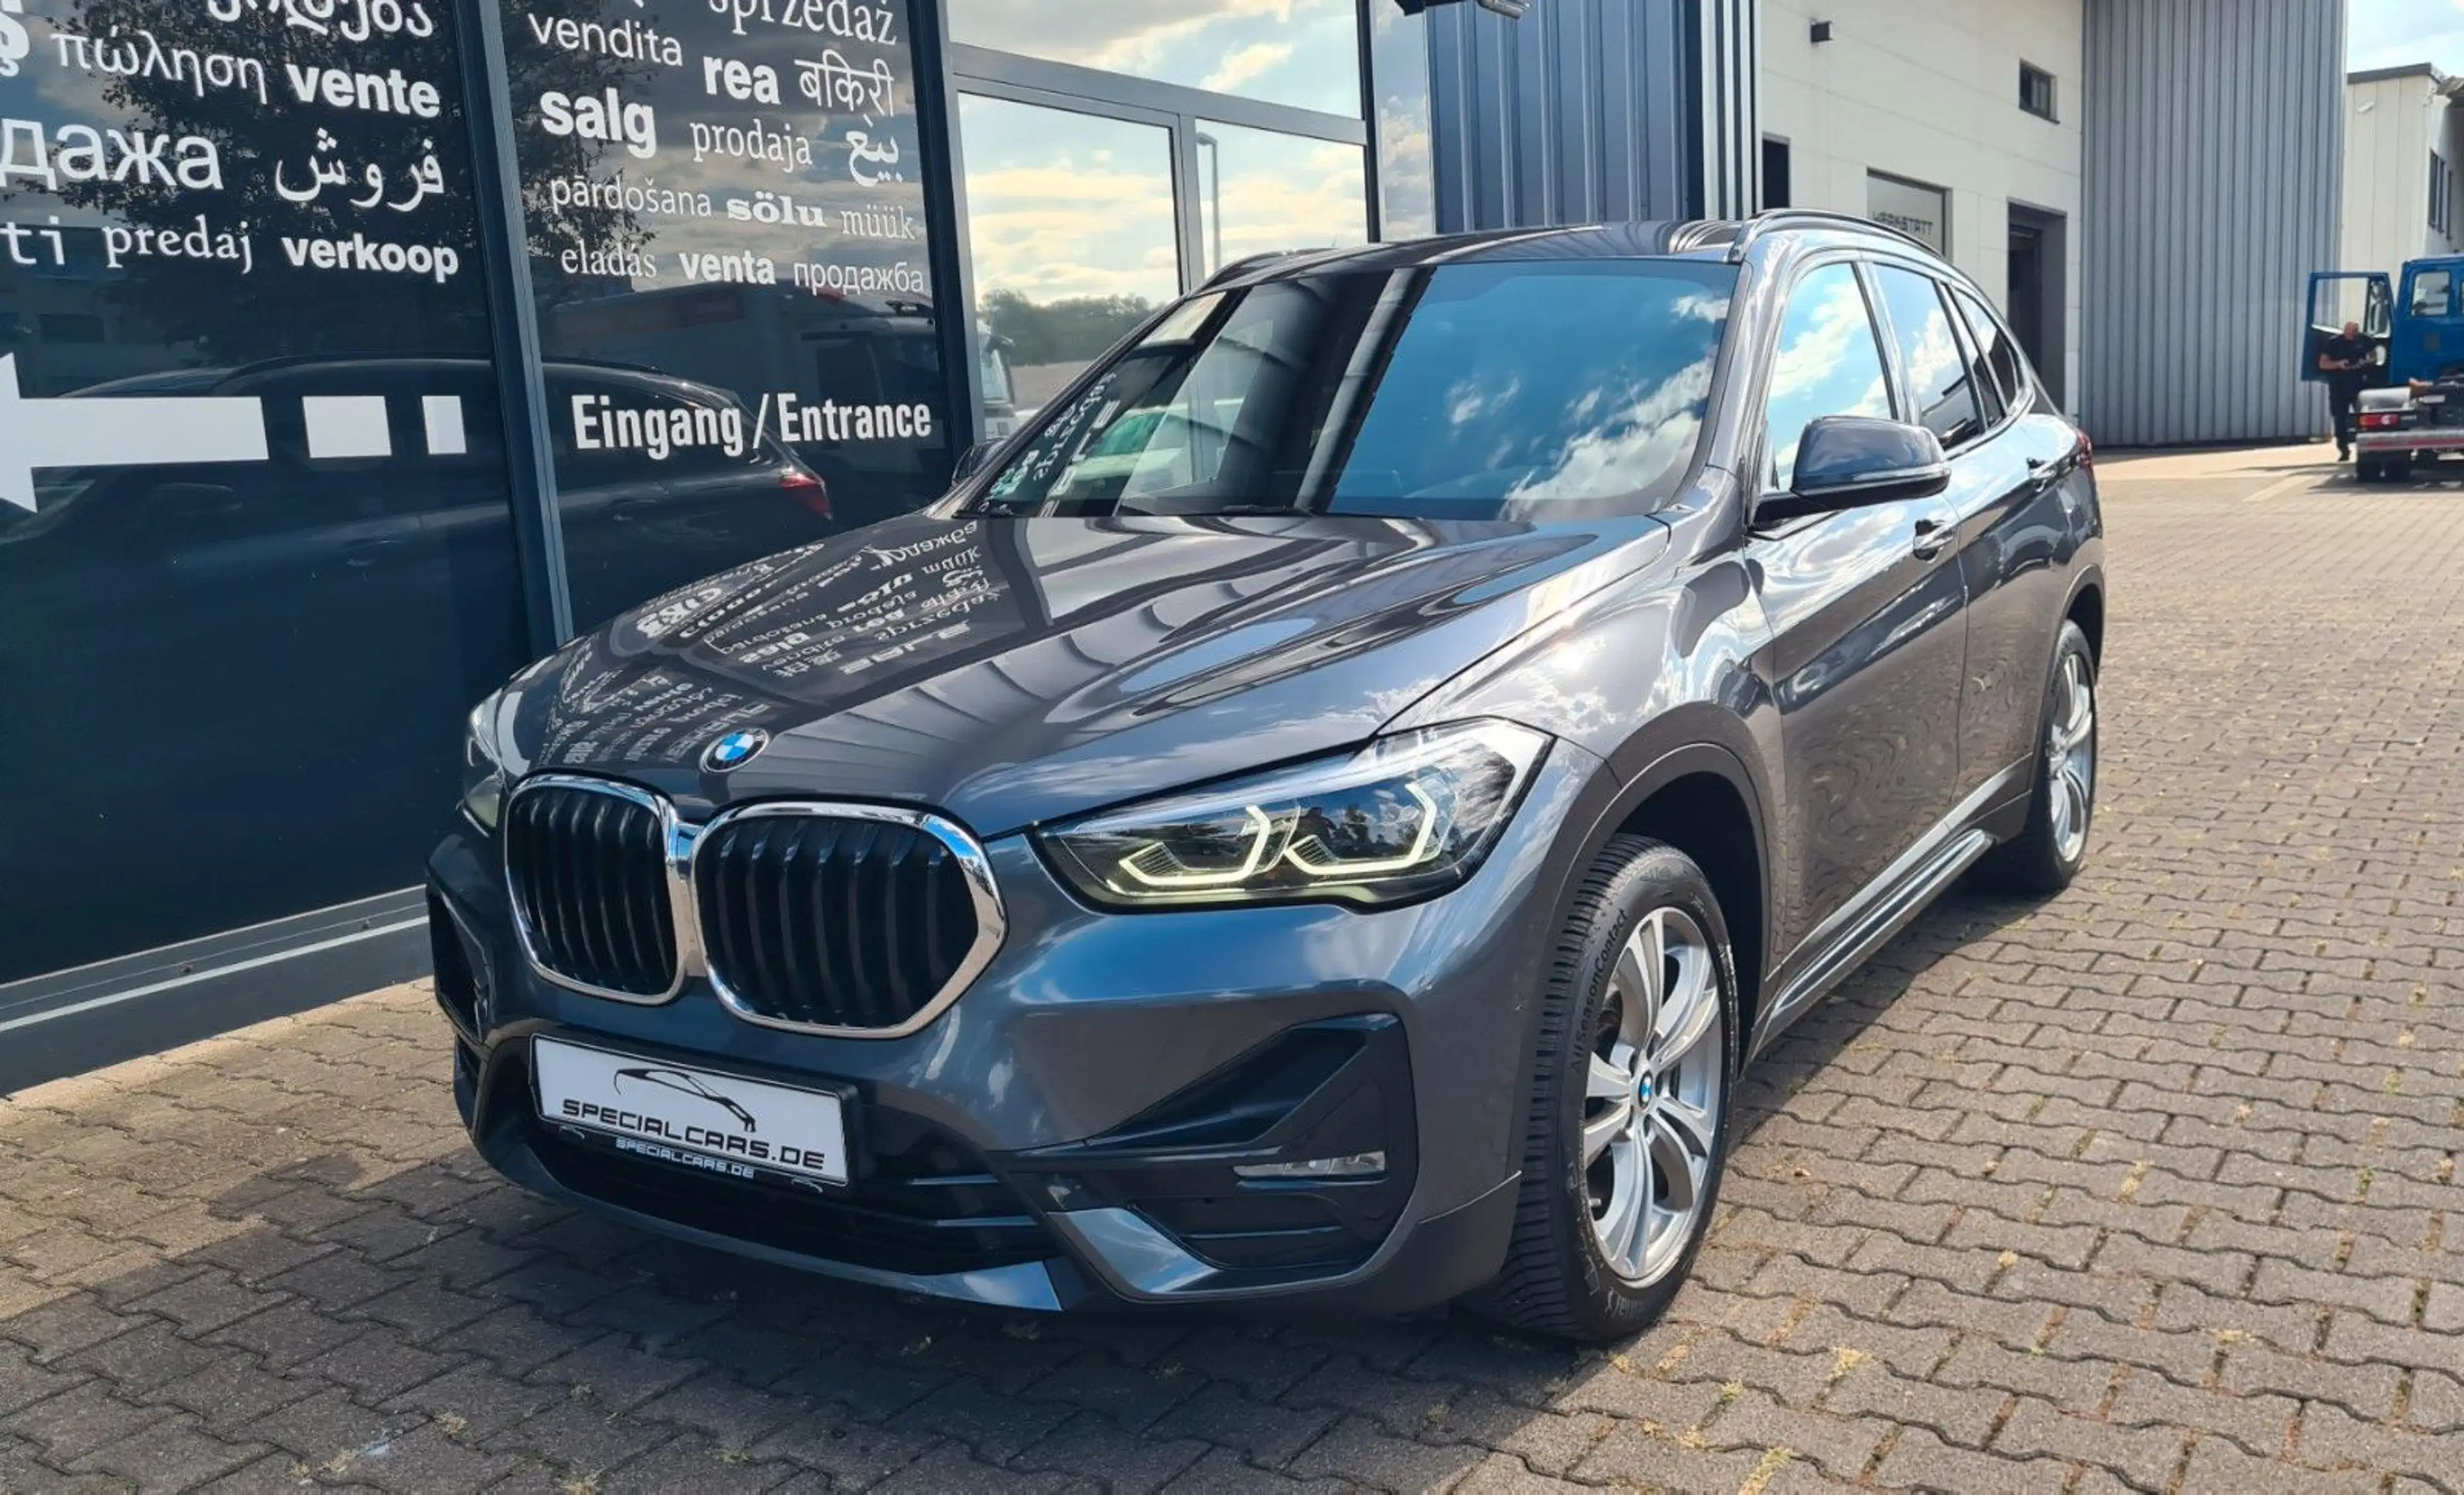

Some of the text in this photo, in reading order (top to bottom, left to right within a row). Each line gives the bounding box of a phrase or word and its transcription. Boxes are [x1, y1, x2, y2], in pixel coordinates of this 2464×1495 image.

[50, 25, 268, 104] πώληση
[527, 13, 683, 67] vendita
[286, 65, 441, 118] vente
[703, 55, 782, 105] rea
[0, 118, 224, 190] дажа
[540, 87, 657, 159] salg
[690, 118, 813, 174] prodaja
[275, 128, 445, 212] فروش
[549, 175, 916, 241] pārdošana sölu müük
[101, 214, 253, 275] predaj
[280, 233, 459, 284] verkoop
[560, 240, 925, 297] eladás venta продажба
[570, 394, 744, 460] Eingang
[777, 392, 932, 444] Entrance
[563, 1098, 825, 1169] SPECIALCARS.DE
[615, 1137, 755, 1179] SPECIALCARS.DE
